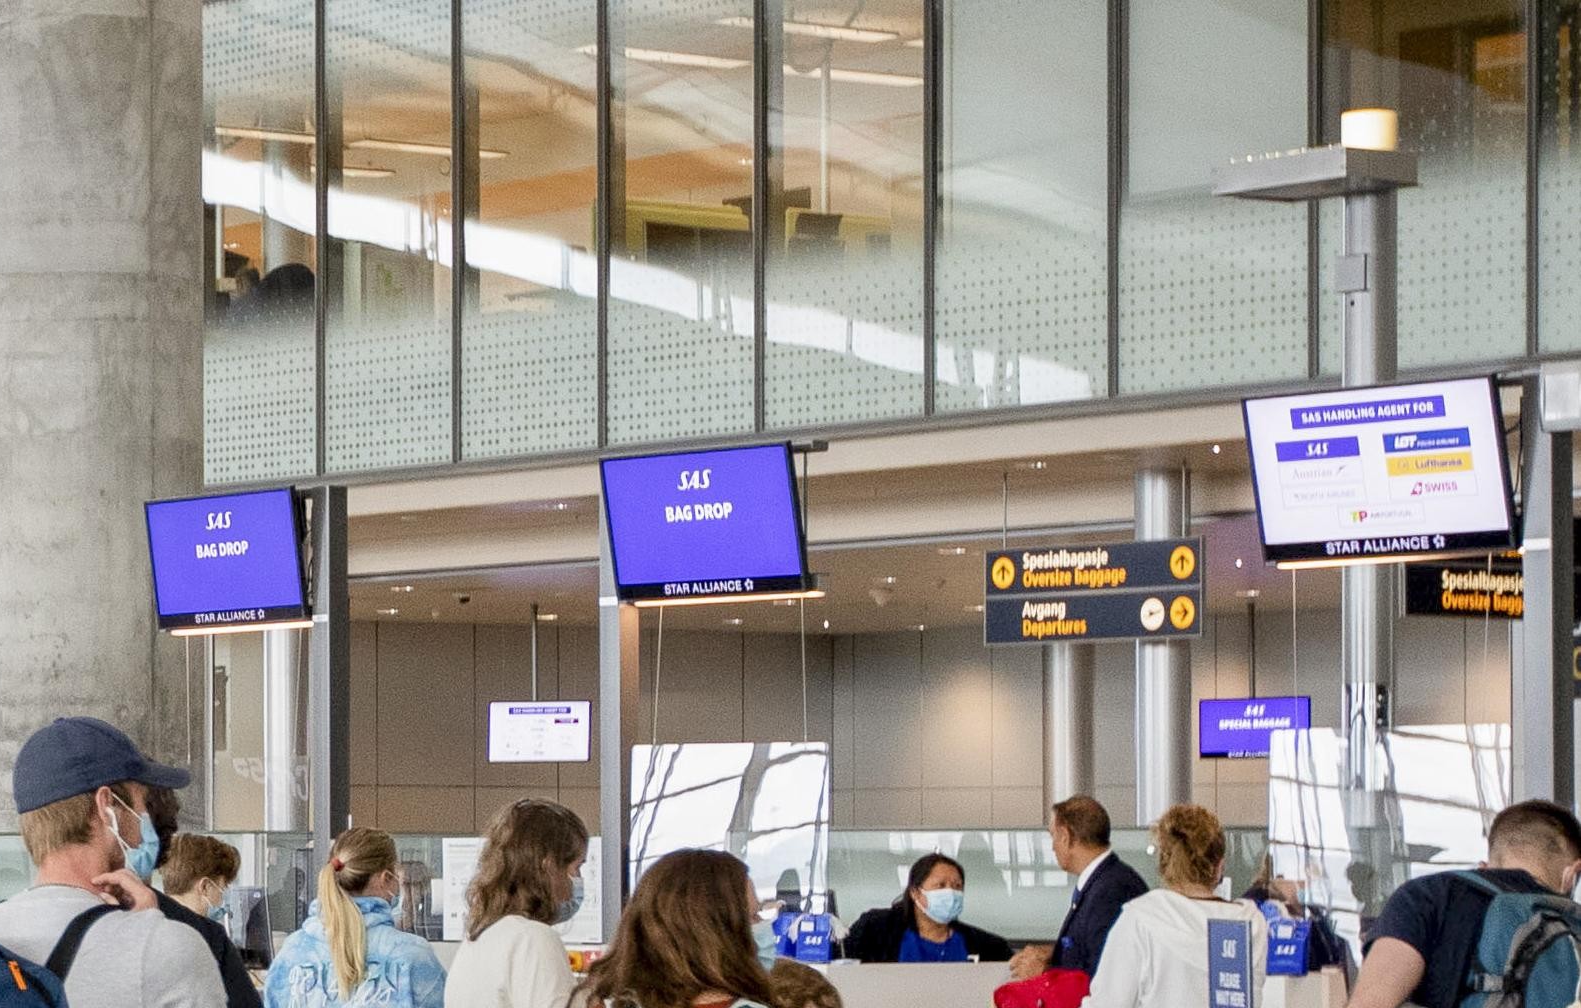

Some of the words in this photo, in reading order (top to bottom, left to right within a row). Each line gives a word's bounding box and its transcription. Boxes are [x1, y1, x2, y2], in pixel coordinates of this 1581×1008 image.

[1302, 412, 1322, 424] SAS
[1323, 406, 1375, 422] HANDLING
[1378, 402, 1410, 417] AGENT
[1413, 401, 1434, 413] FOR
[1306, 442, 1329, 456] SAS
[1415, 458, 1462, 470] Lufthansa
[677, 469, 712, 491] SAS
[1425, 480, 1458, 492] SWISS
[205, 511, 232, 530] SAS
[665, 505, 692, 522] BAG
[694, 502, 733, 521] DROP
[196, 543, 218, 560] BAG
[218, 540, 248, 558] DROP
[1326, 540, 1360, 556] STAR
[1363, 536, 1430, 554] ALLIANCE
[1022, 548, 1108, 570] Spesialbagasje
[1022, 568, 1072, 588] Oversize
[1074, 567, 1126, 588] baggage
[664, 582, 690, 596] STAR
[692, 579, 742, 594] ALLIANCE
[1022, 601, 1066, 620] Avgang
[1493, 593, 1524, 616] bagg
[194, 613, 216, 624] STAR
[216, 610, 256, 623] ALLIANCE
[1022, 618, 1087, 639] Departures
[1219, 718, 1252, 730] SPECIAL
[1253, 717, 1291, 730] BAGGAGE
[1222, 939, 1238, 958] SAS
[1275, 944, 1298, 956] SAS
[1219, 971, 1241, 990] PLEASE
